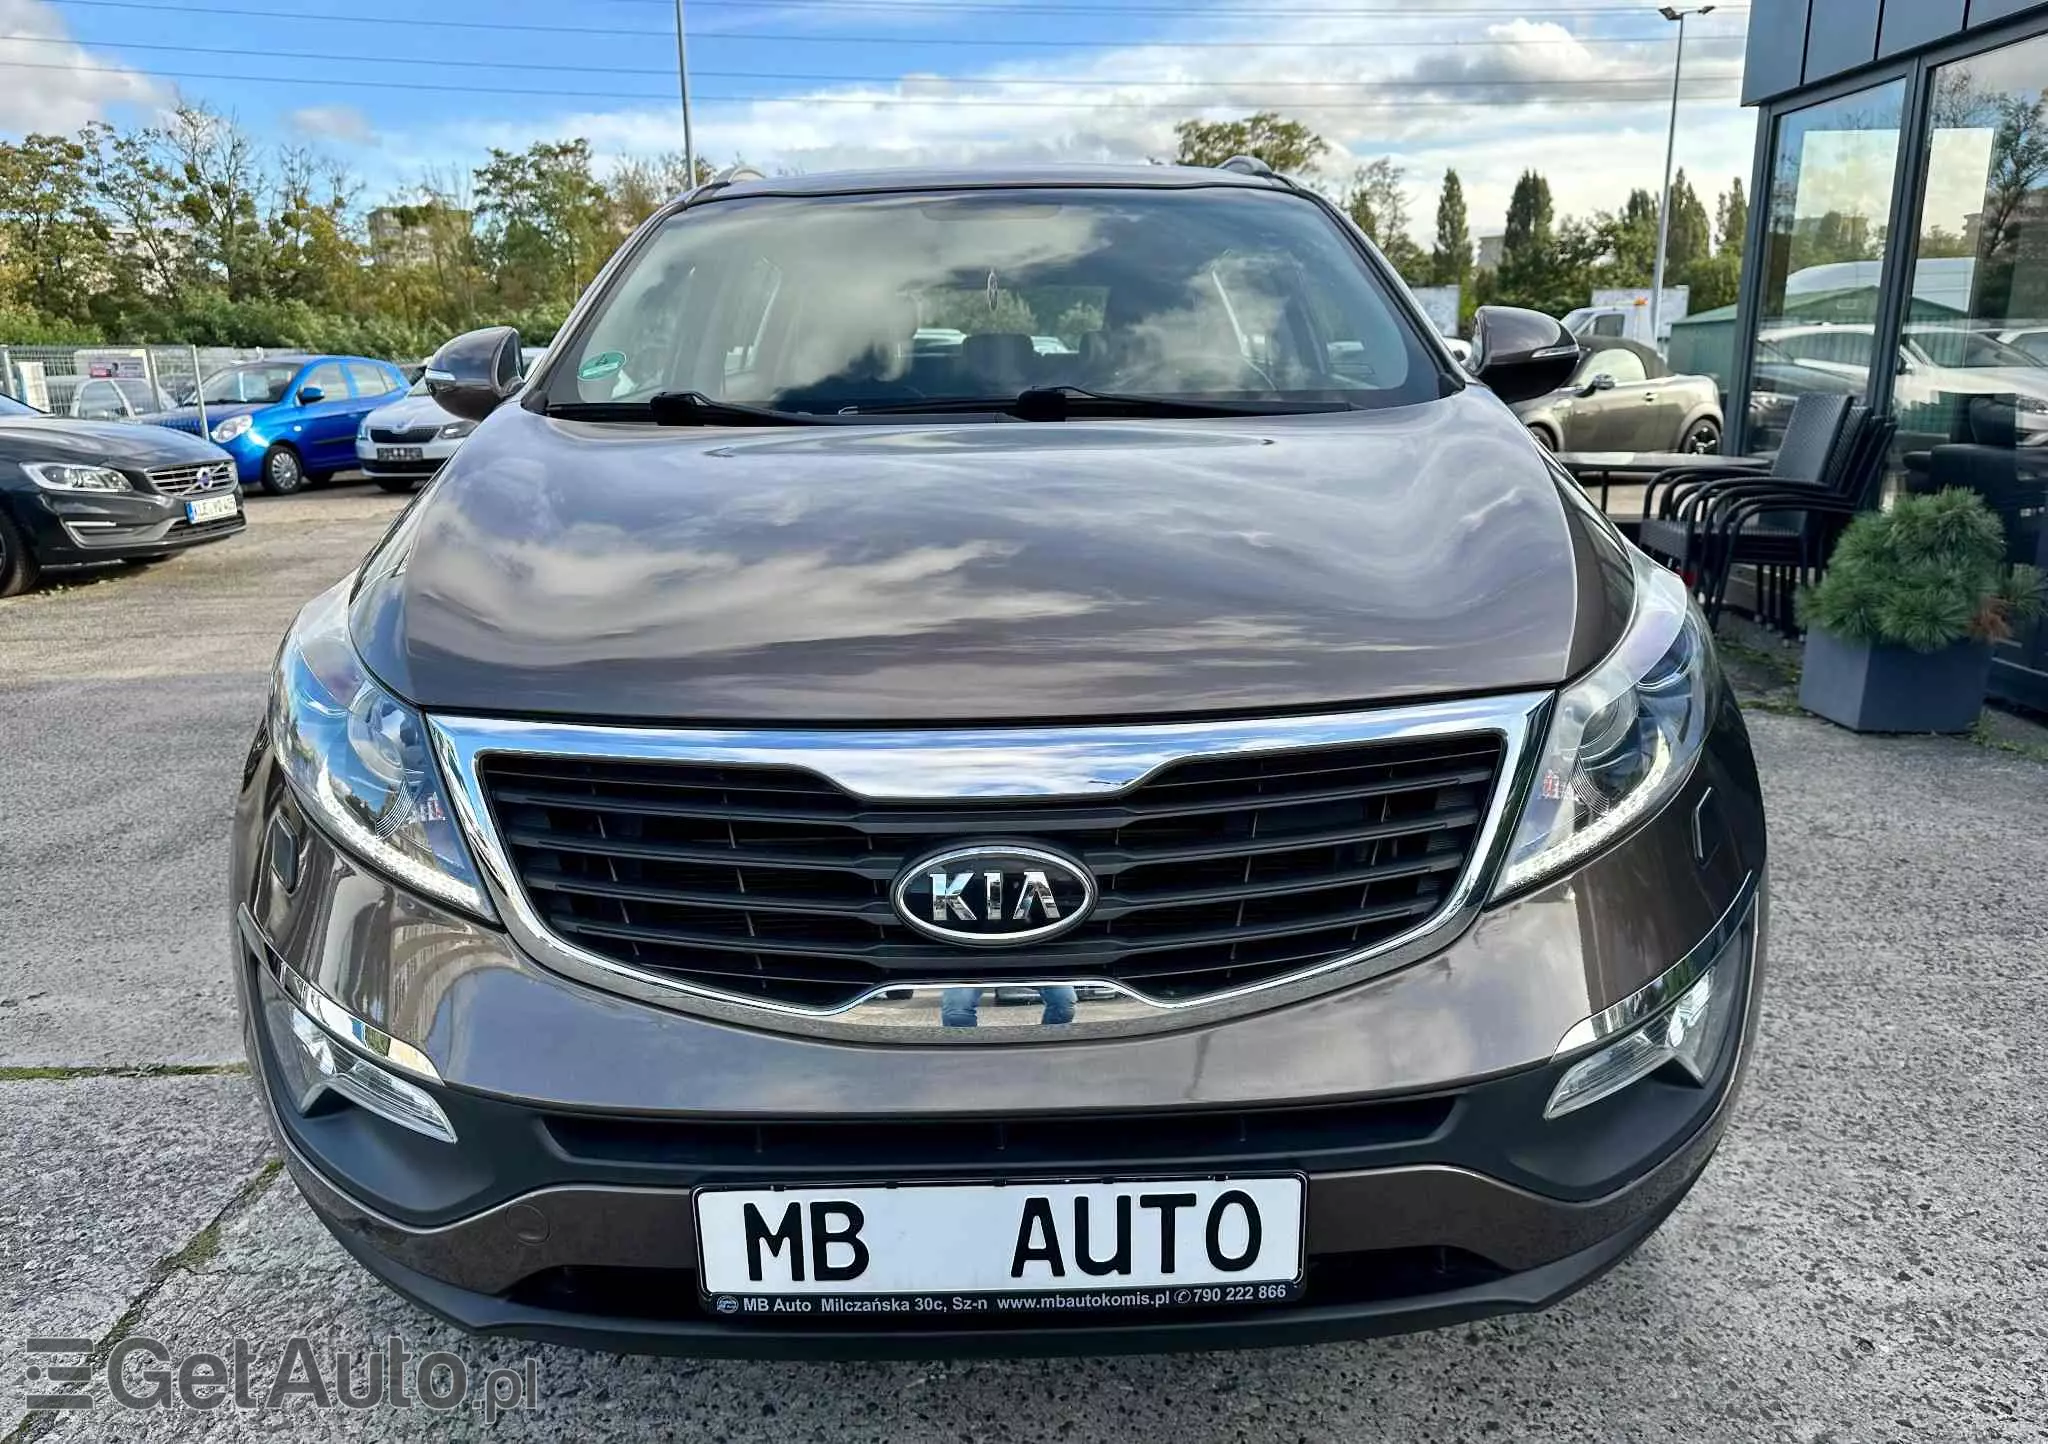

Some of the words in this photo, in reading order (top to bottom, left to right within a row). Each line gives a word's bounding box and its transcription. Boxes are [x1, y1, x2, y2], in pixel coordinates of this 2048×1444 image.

[929, 871, 1061, 920] KIA
[743, 1201, 870, 1282] MB
[1011, 1189, 1263, 1278] AUTO
[743, 1298, 769, 1312] MB
[773, 1298, 812, 1312] Auto
[821, 1297, 910, 1312] Milczańska
[915, 1298, 947, 1313] 30c,
[952, 1296, 988, 1311] Sz-n
[997, 1290, 1170, 1310] www.mbautokomis.pl
[1194, 1288, 1221, 1303] 790
[1226, 1286, 1253, 1301] 222
[1258, 1284, 1286, 1299] 866
